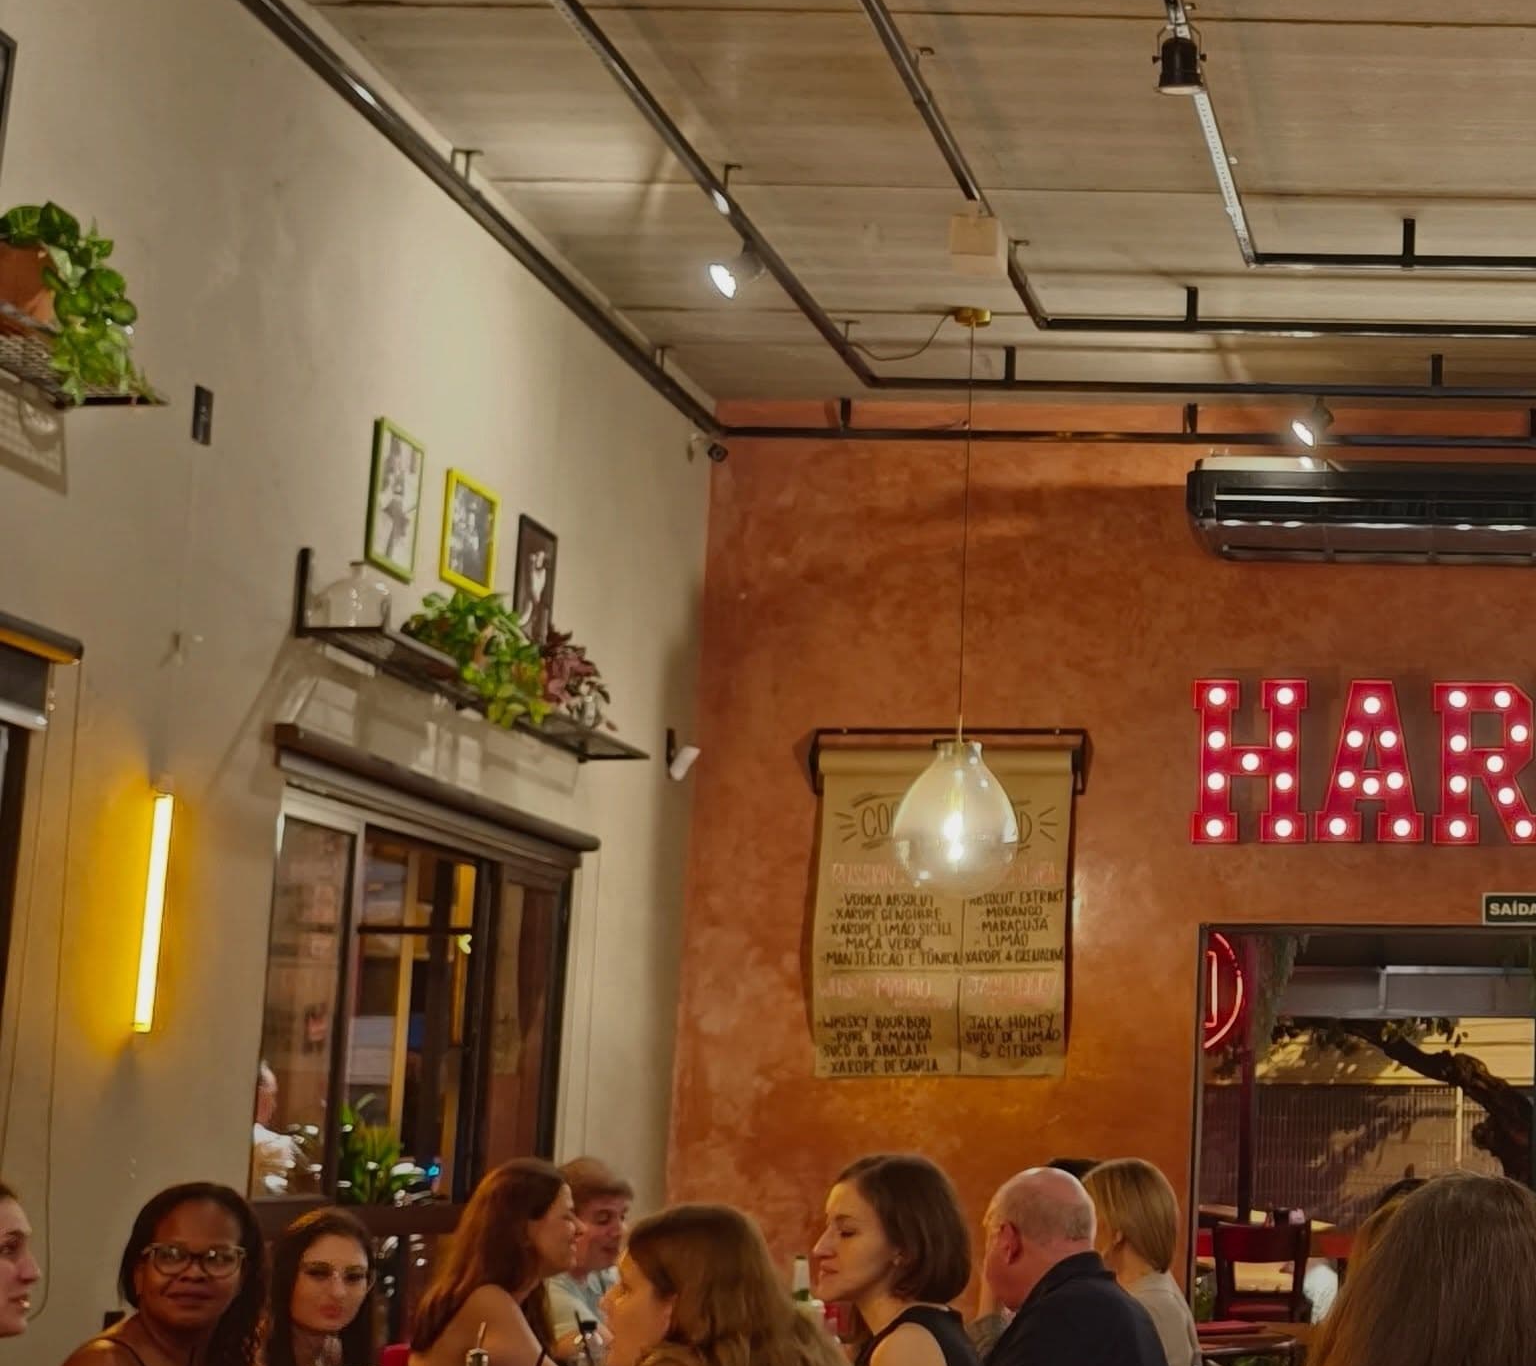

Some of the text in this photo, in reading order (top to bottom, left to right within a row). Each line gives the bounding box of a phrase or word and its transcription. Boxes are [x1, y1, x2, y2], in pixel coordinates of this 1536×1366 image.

[844, 893, 882, 906] VODKA
[986, 906, 1043, 917] MORANGO
[967, 1012, 1054, 1030] JACK HONEY
[998, 1043, 1042, 1058] CITRUS
